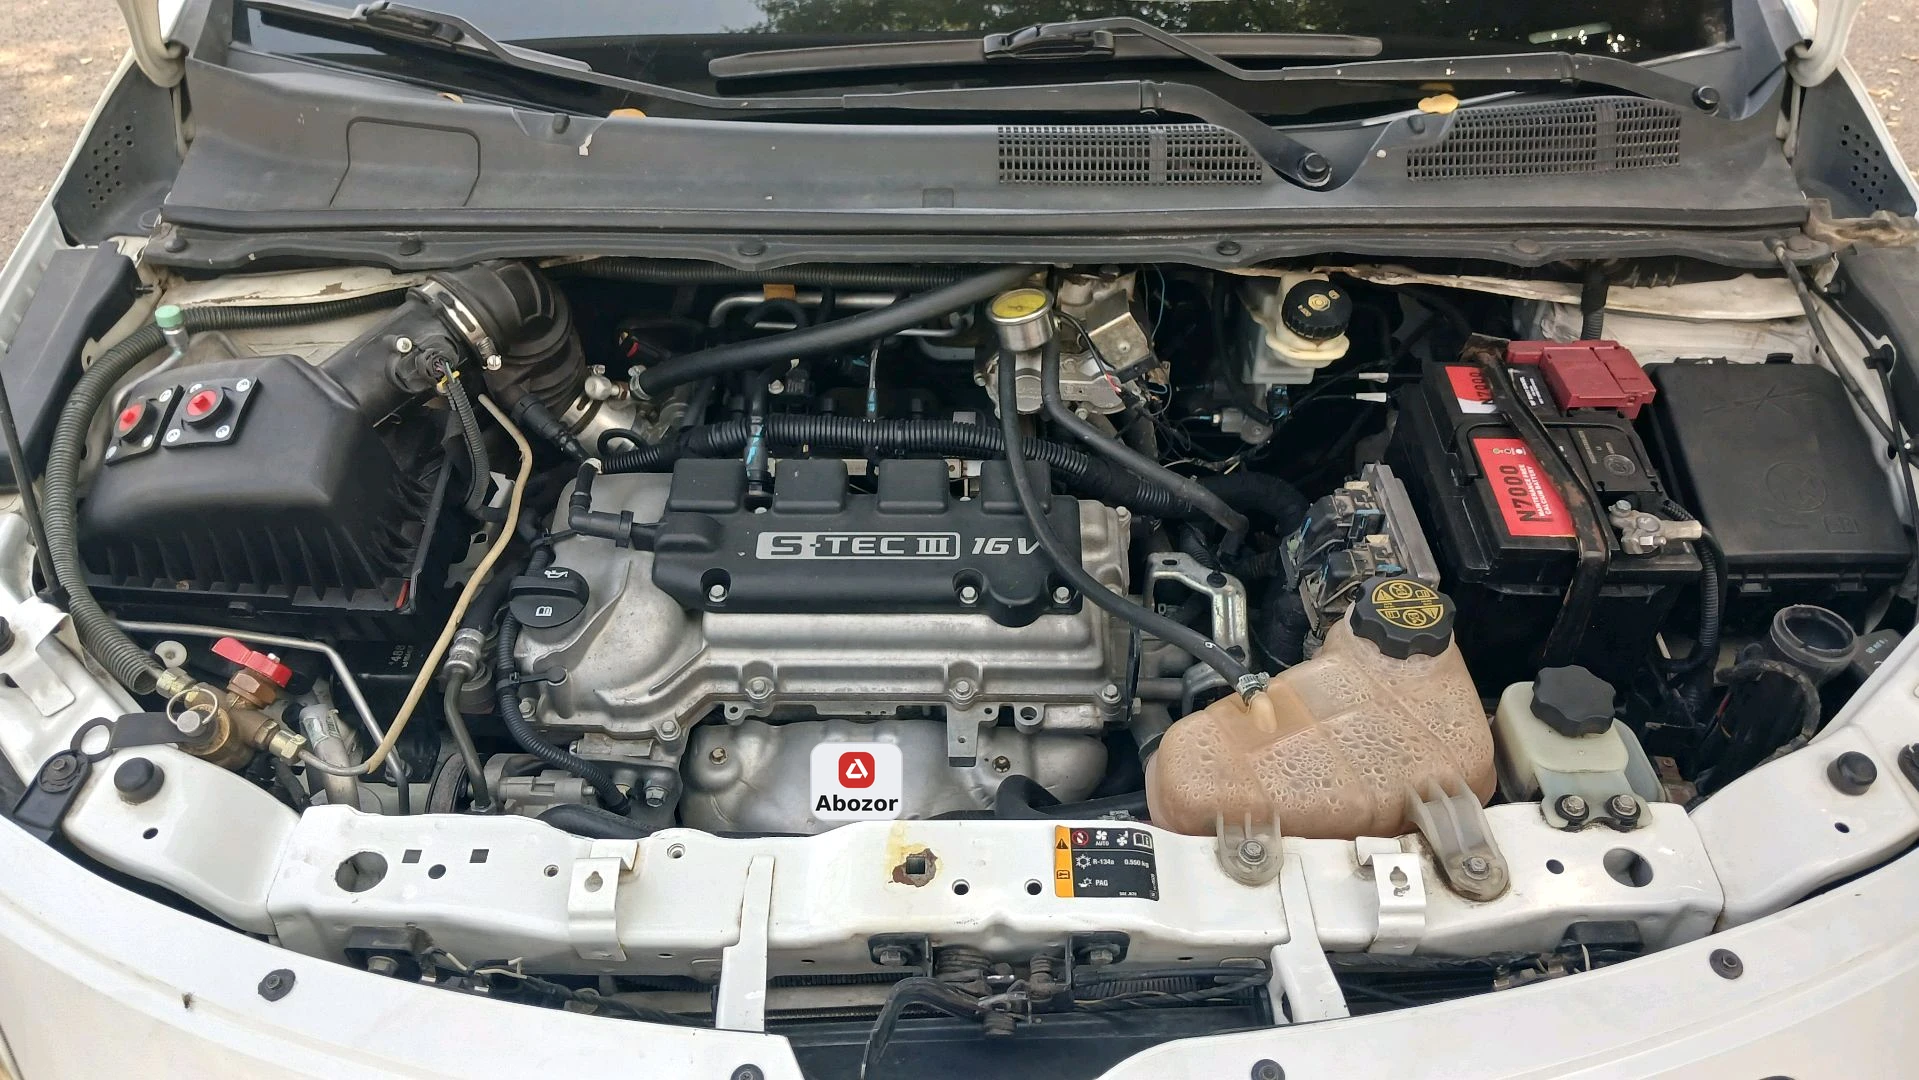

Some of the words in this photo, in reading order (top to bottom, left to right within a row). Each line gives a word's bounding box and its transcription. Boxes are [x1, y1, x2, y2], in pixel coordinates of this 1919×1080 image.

[1526, 466, 1542, 490] BATTERY
[1499, 465, 1554, 521] N7000
[1523, 478, 1546, 516] MAINTENANCE
[1536, 490, 1552, 515] CALCIUM
[770, 535, 905, 556] S-TEC
[916, 537, 950, 555] III
[1142, 861, 1150, 869] kg
[1095, 879, 1108, 887] PAG
